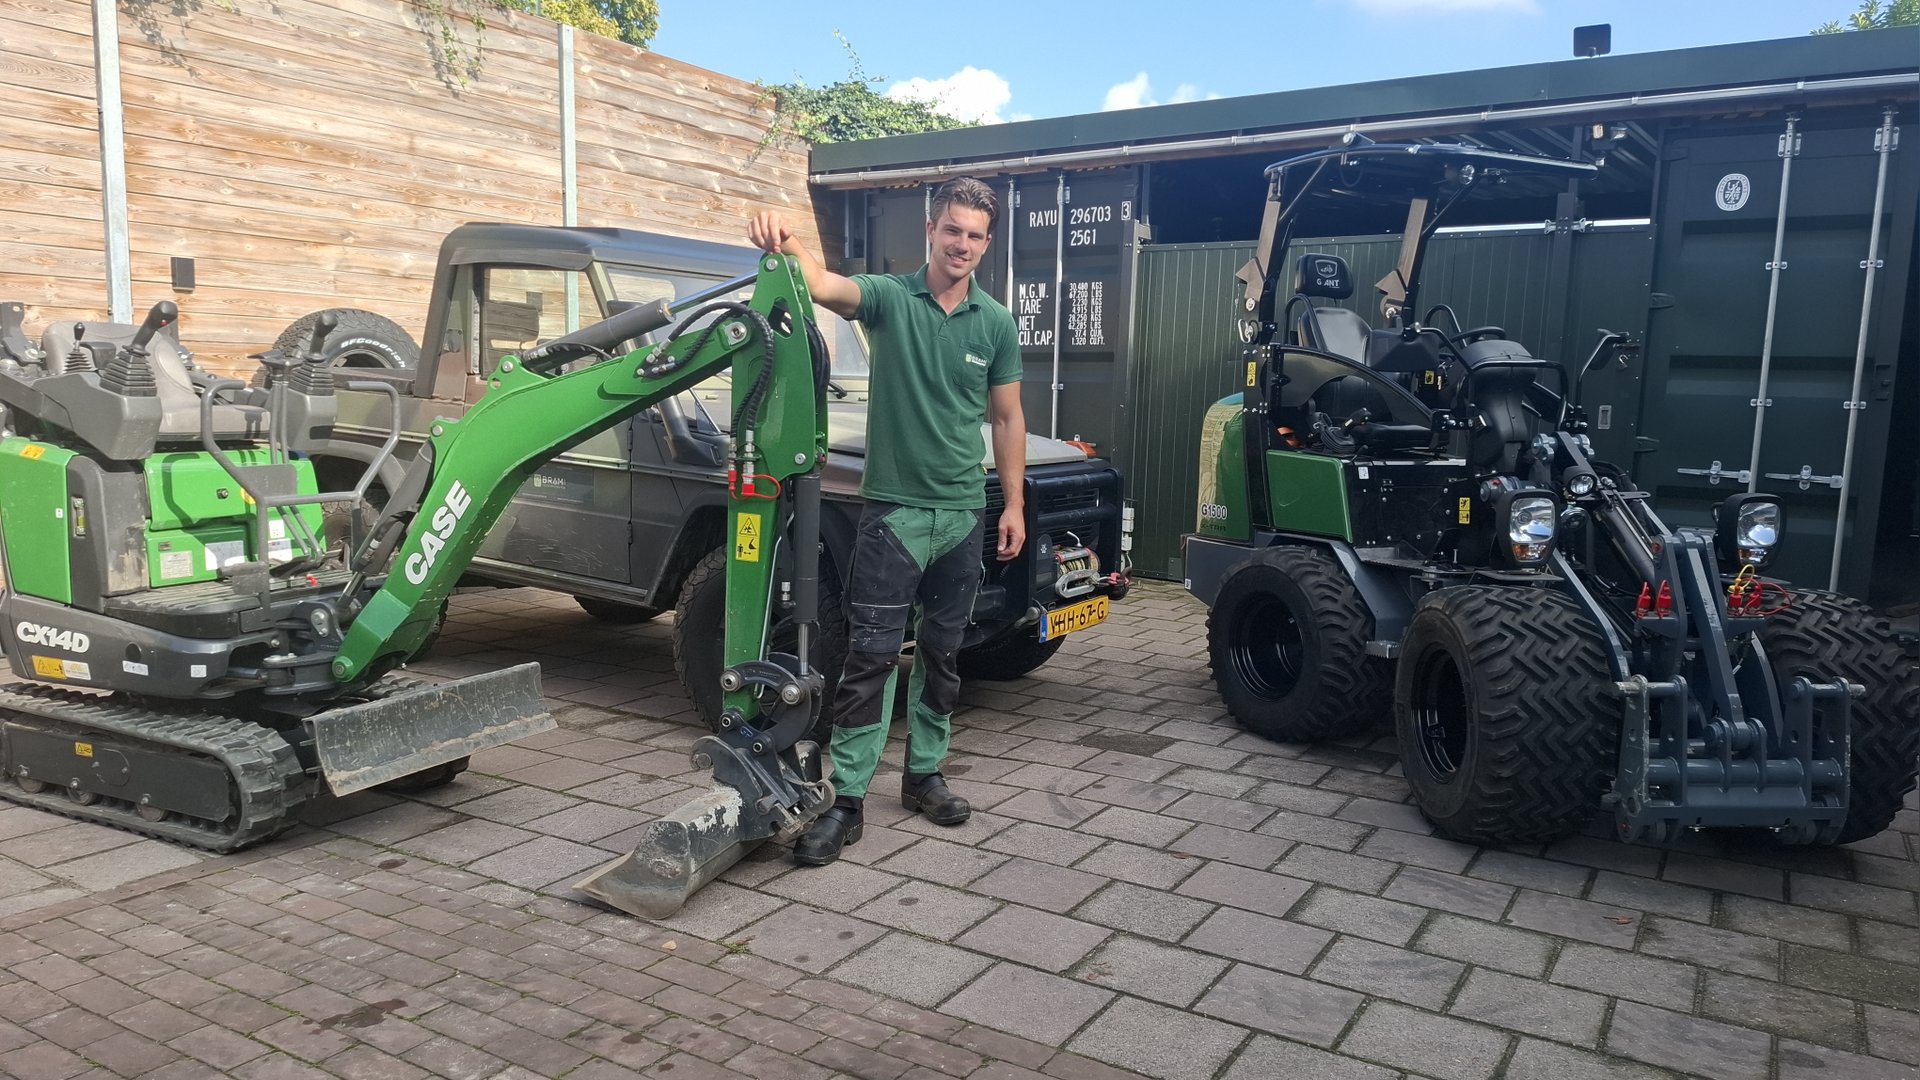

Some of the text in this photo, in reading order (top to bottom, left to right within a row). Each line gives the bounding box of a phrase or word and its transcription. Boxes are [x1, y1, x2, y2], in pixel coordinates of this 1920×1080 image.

[1029, 202, 1131, 228] RAYU 296703 3
[1070, 229, 1097, 246] 25G1
[1091, 281, 1103, 290] KGS
[1316, 278, 1340, 287] GANT
[1019, 283, 1049, 299] M.G.W.
[1091, 289, 1103, 298] LBS
[1019, 298, 1042, 314] TARE
[1091, 297, 1103, 306] KGS
[1091, 305, 1102, 314] LBS
[1018, 315, 1036, 331] NET
[1090, 313, 1102, 322] KGS
[1090, 321, 1102, 330] LBS
[1201, 503, 1227, 520] G1500
[404, 479, 472, 585] CASE
[16, 621, 90, 653] CX14D
